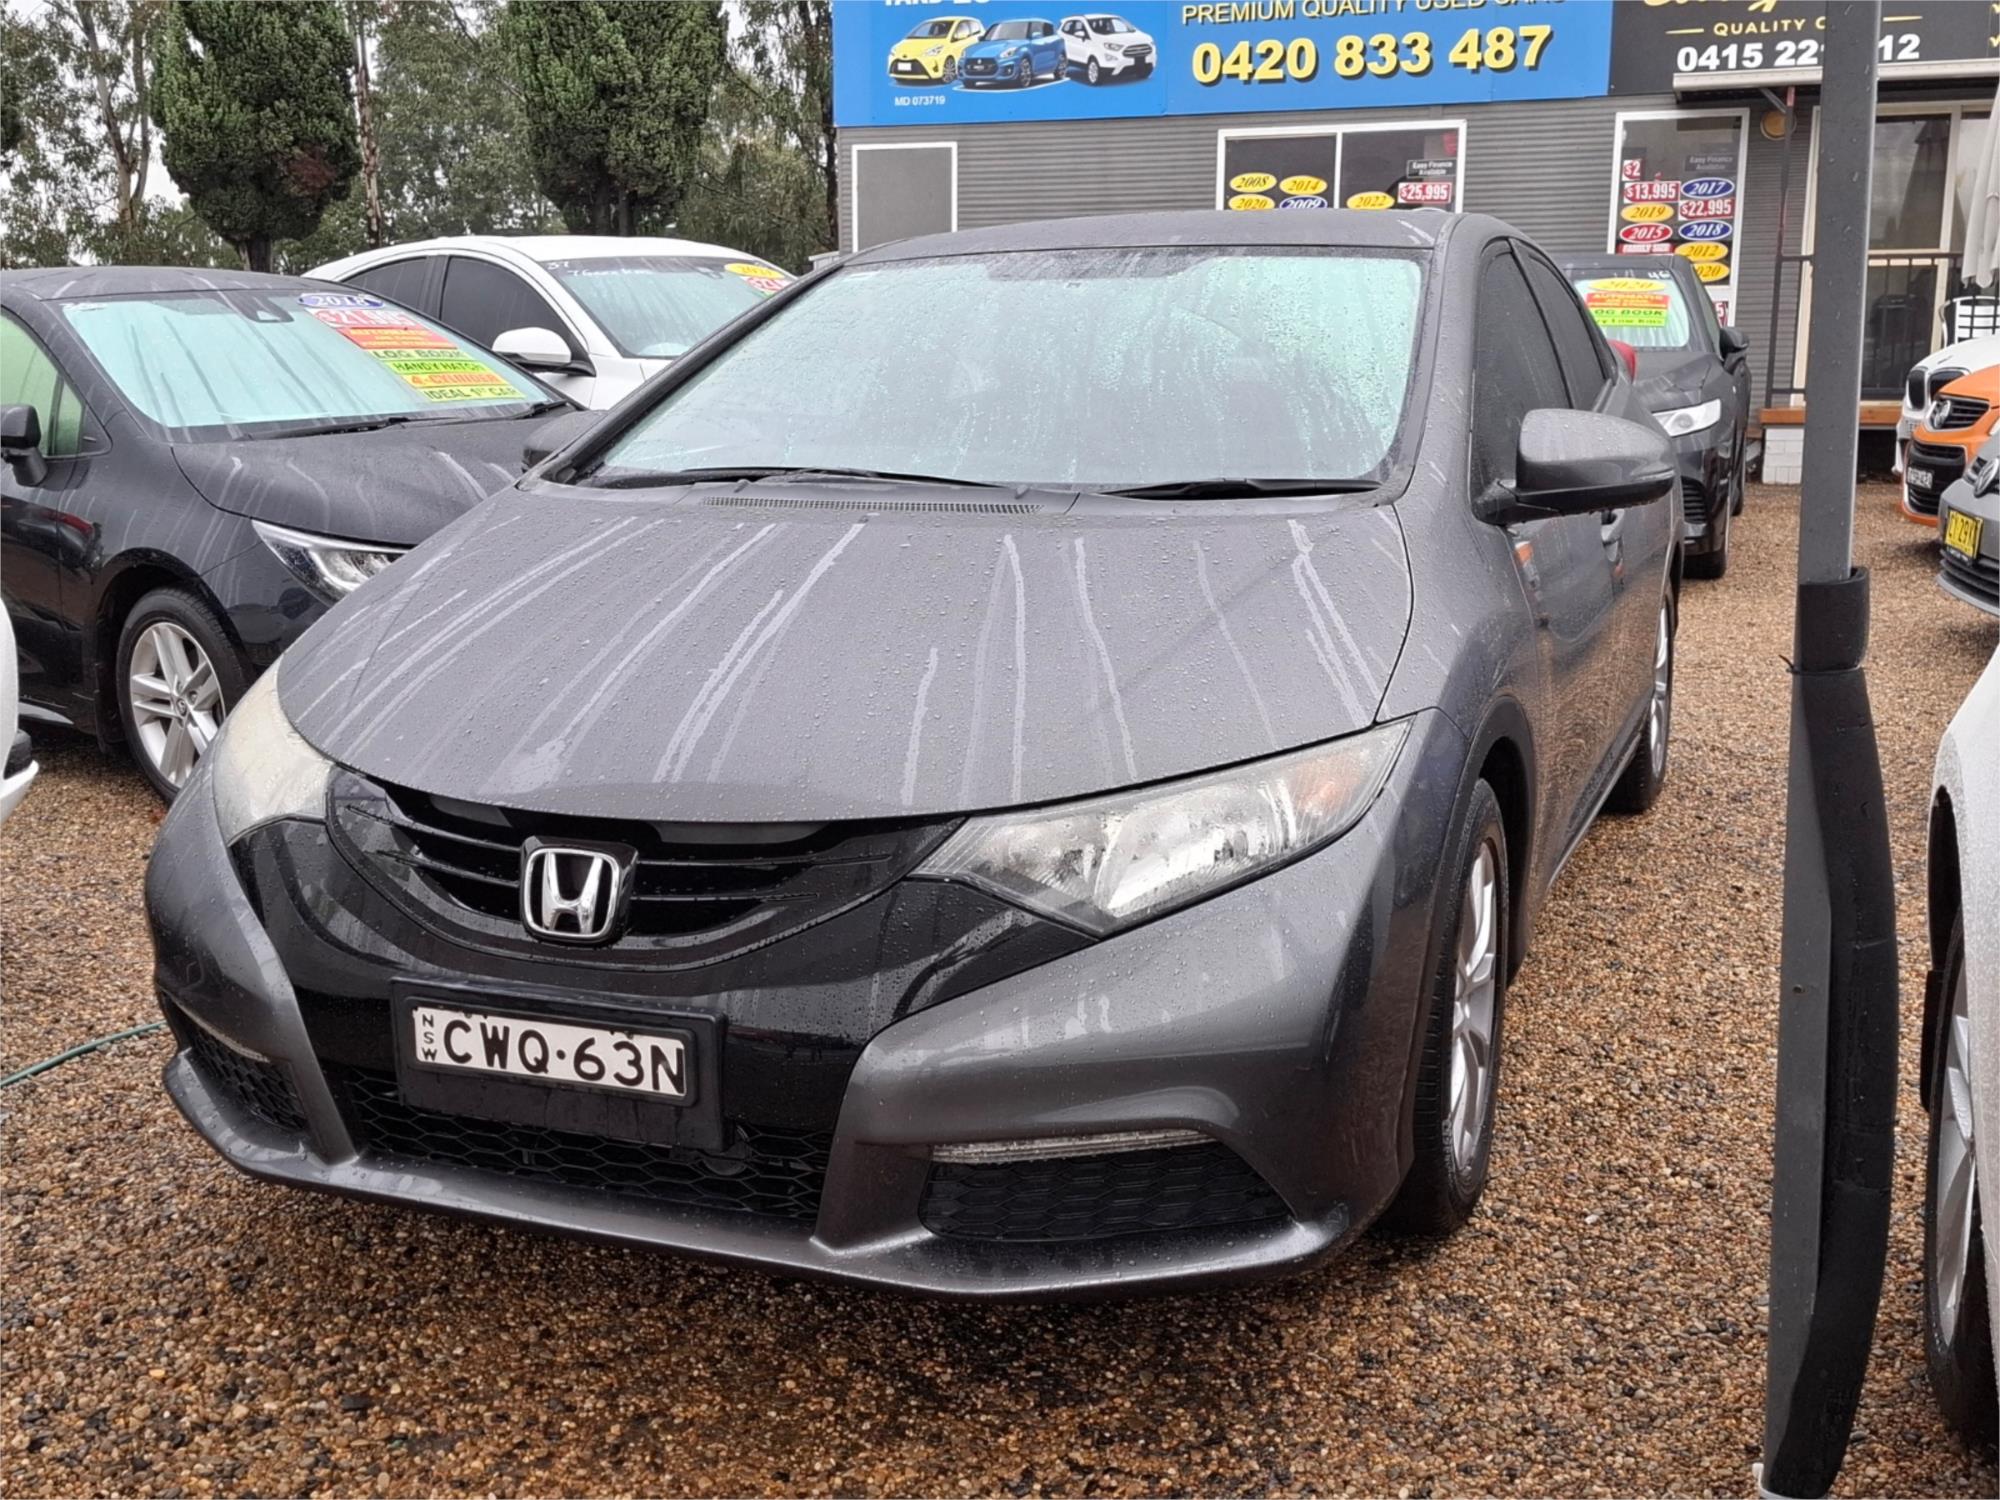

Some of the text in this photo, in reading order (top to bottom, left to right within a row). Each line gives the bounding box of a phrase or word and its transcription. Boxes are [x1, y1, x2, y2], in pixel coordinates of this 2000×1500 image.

[1183, 1, 1294, 25] PREMIUM
[1302, 0, 1403, 17] QUALITY
[1713, 18, 1806, 36] QUALITY
[1192, 25, 1551, 84] 0420 833 487
[1677, 43, 1763, 71] 0415
[1773, 39, 1824, 67] 22
[894, 95, 946, 106] MD 073719
[1236, 176, 1269, 188] 2008
[1287, 180, 1320, 192] 2014
[1690, 182, 1726, 195] 2017
[1401, 185, 1448, 200] $25,995
[1626, 183, 1676, 199] $13,995
[1630, 206, 1666, 219] 2019
[1681, 200, 1731, 216] $22,995
[1627, 226, 1664, 240] 2015
[1687, 223, 1724, 236] 2018
[1684, 245, 1719, 257] 2012
[1697, 266, 1721, 278] 020
[373, 350, 413, 359] LOG
[392, 362, 439, 371] HANDY
[424, 389, 471, 399] IDEAL
